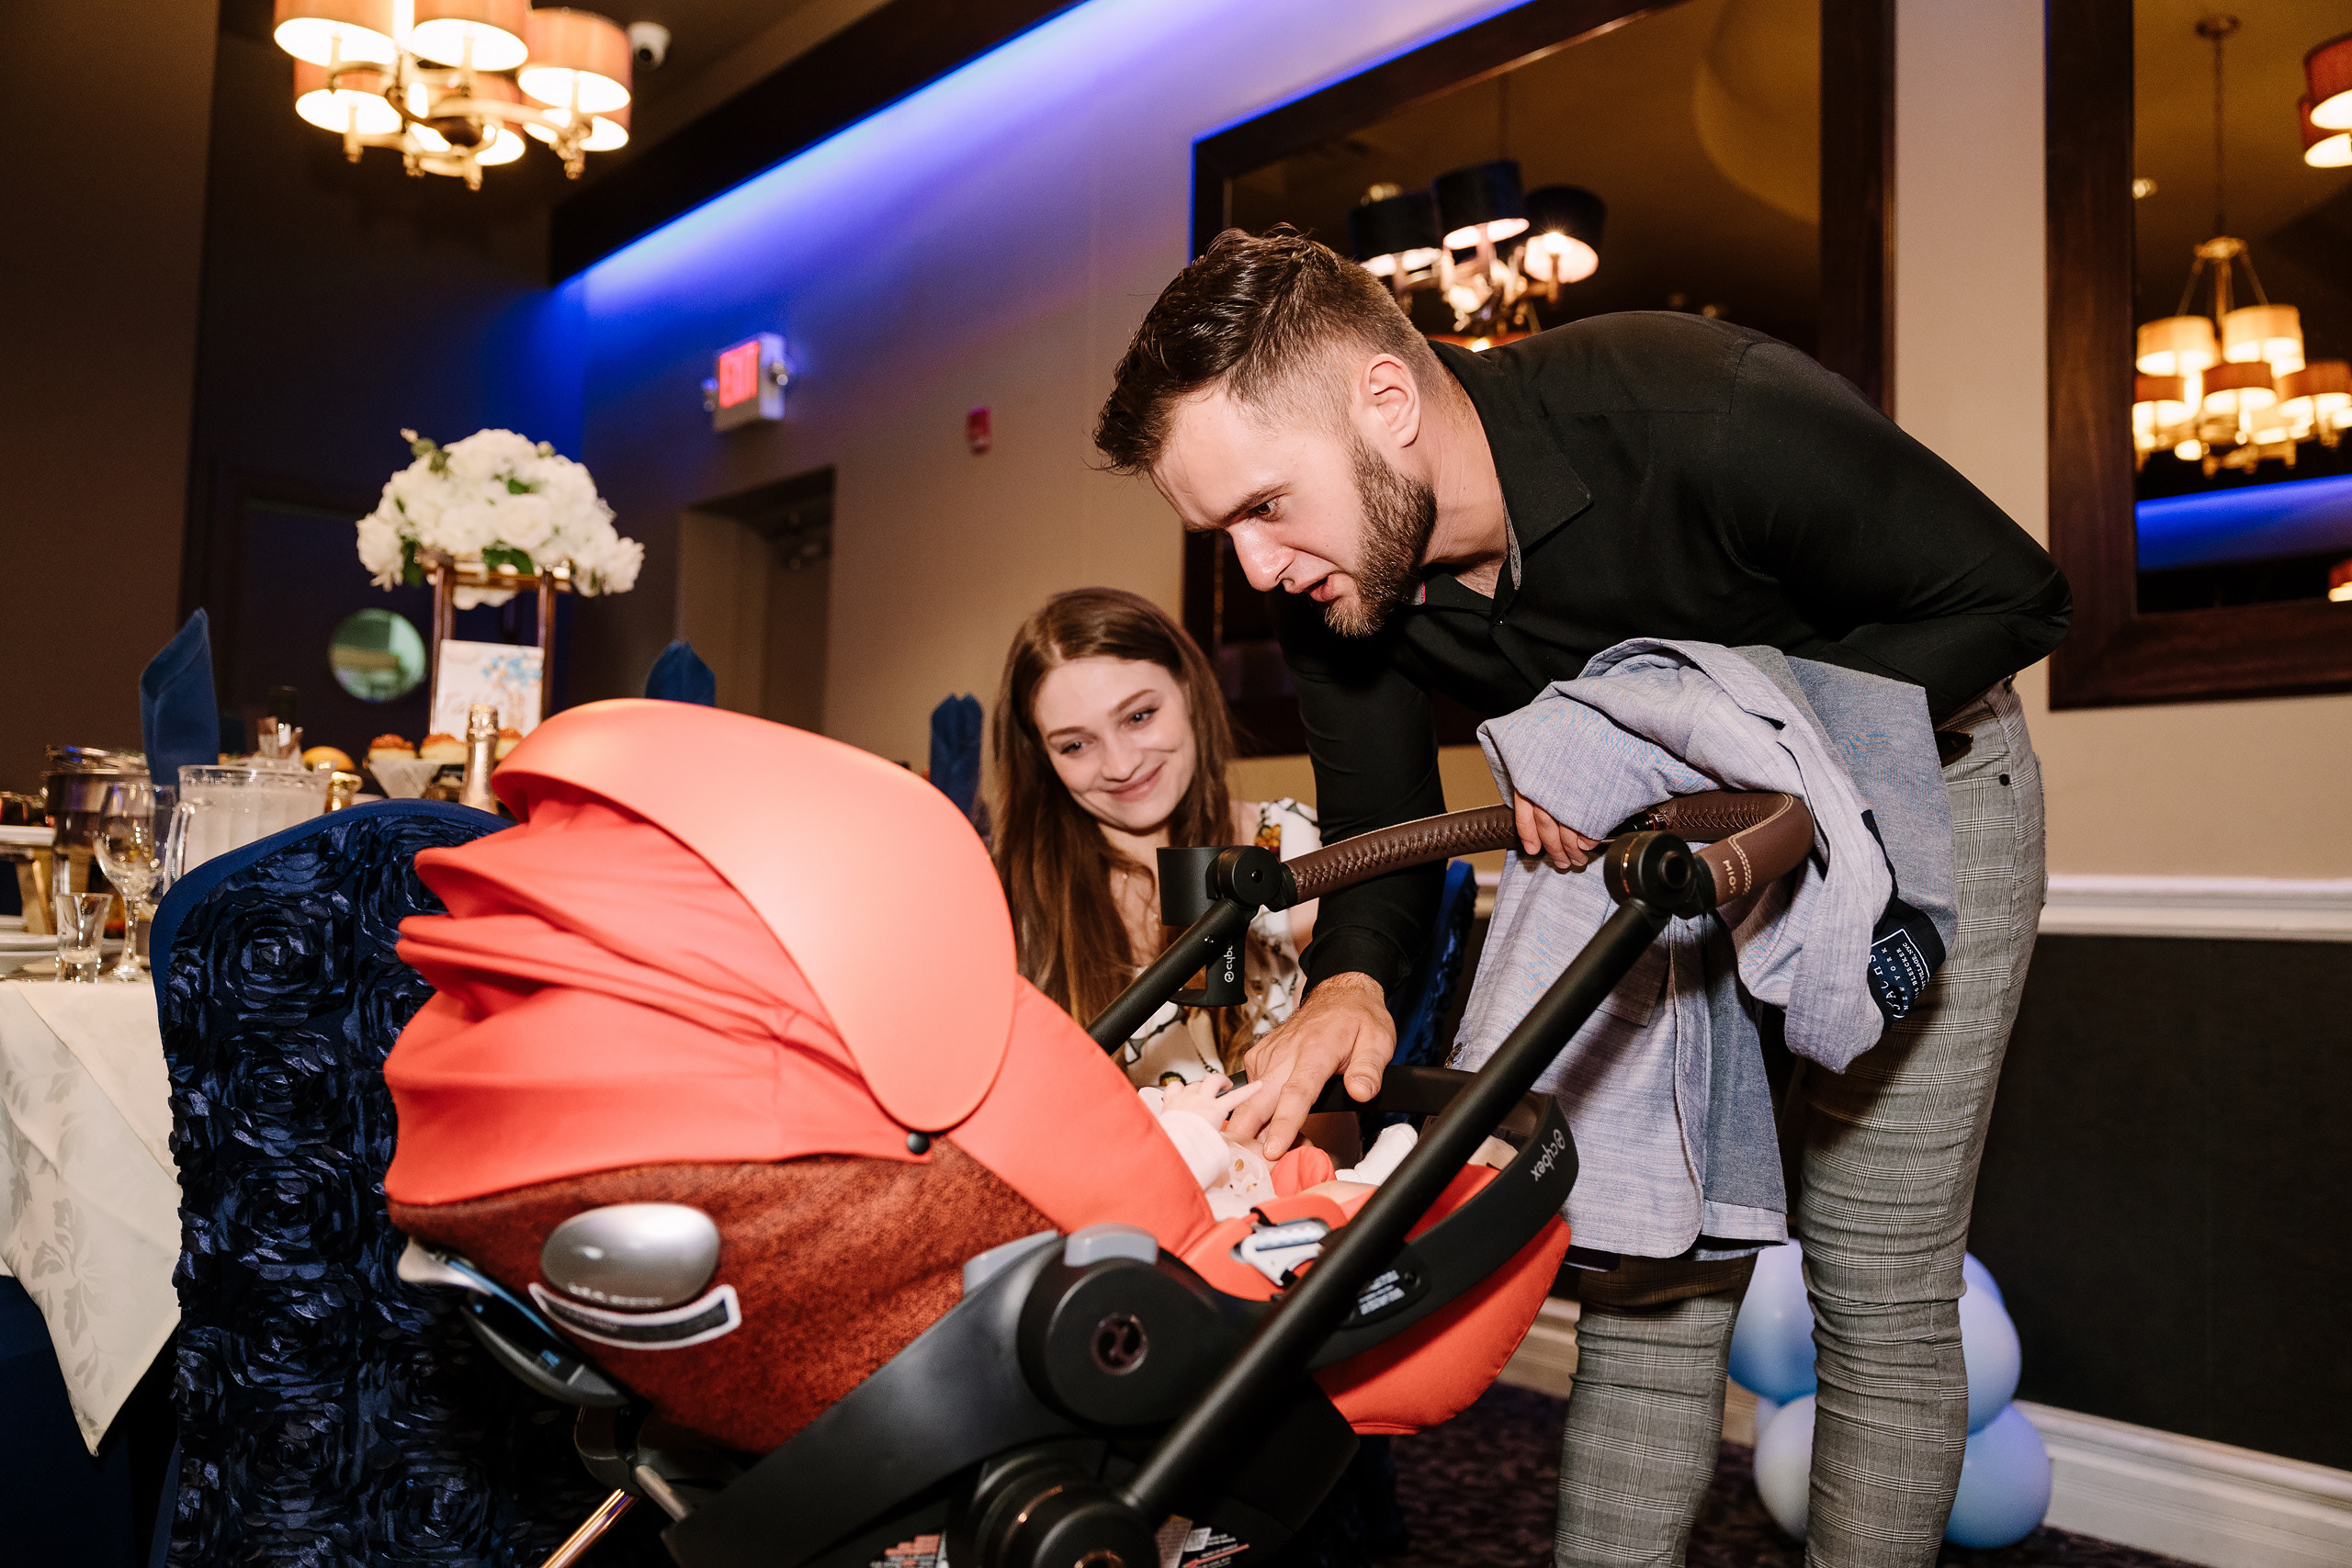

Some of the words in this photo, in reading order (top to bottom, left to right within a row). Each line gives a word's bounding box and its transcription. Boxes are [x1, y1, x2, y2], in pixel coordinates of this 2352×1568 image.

[1881, 947, 1901, 981] YORK
[1902, 942, 1914, 955] NYC
[1896, 947, 1918, 987] BLEECKER
[1898, 987, 1909, 1010] NEW
[1530, 1142, 1560, 1182] cybex
